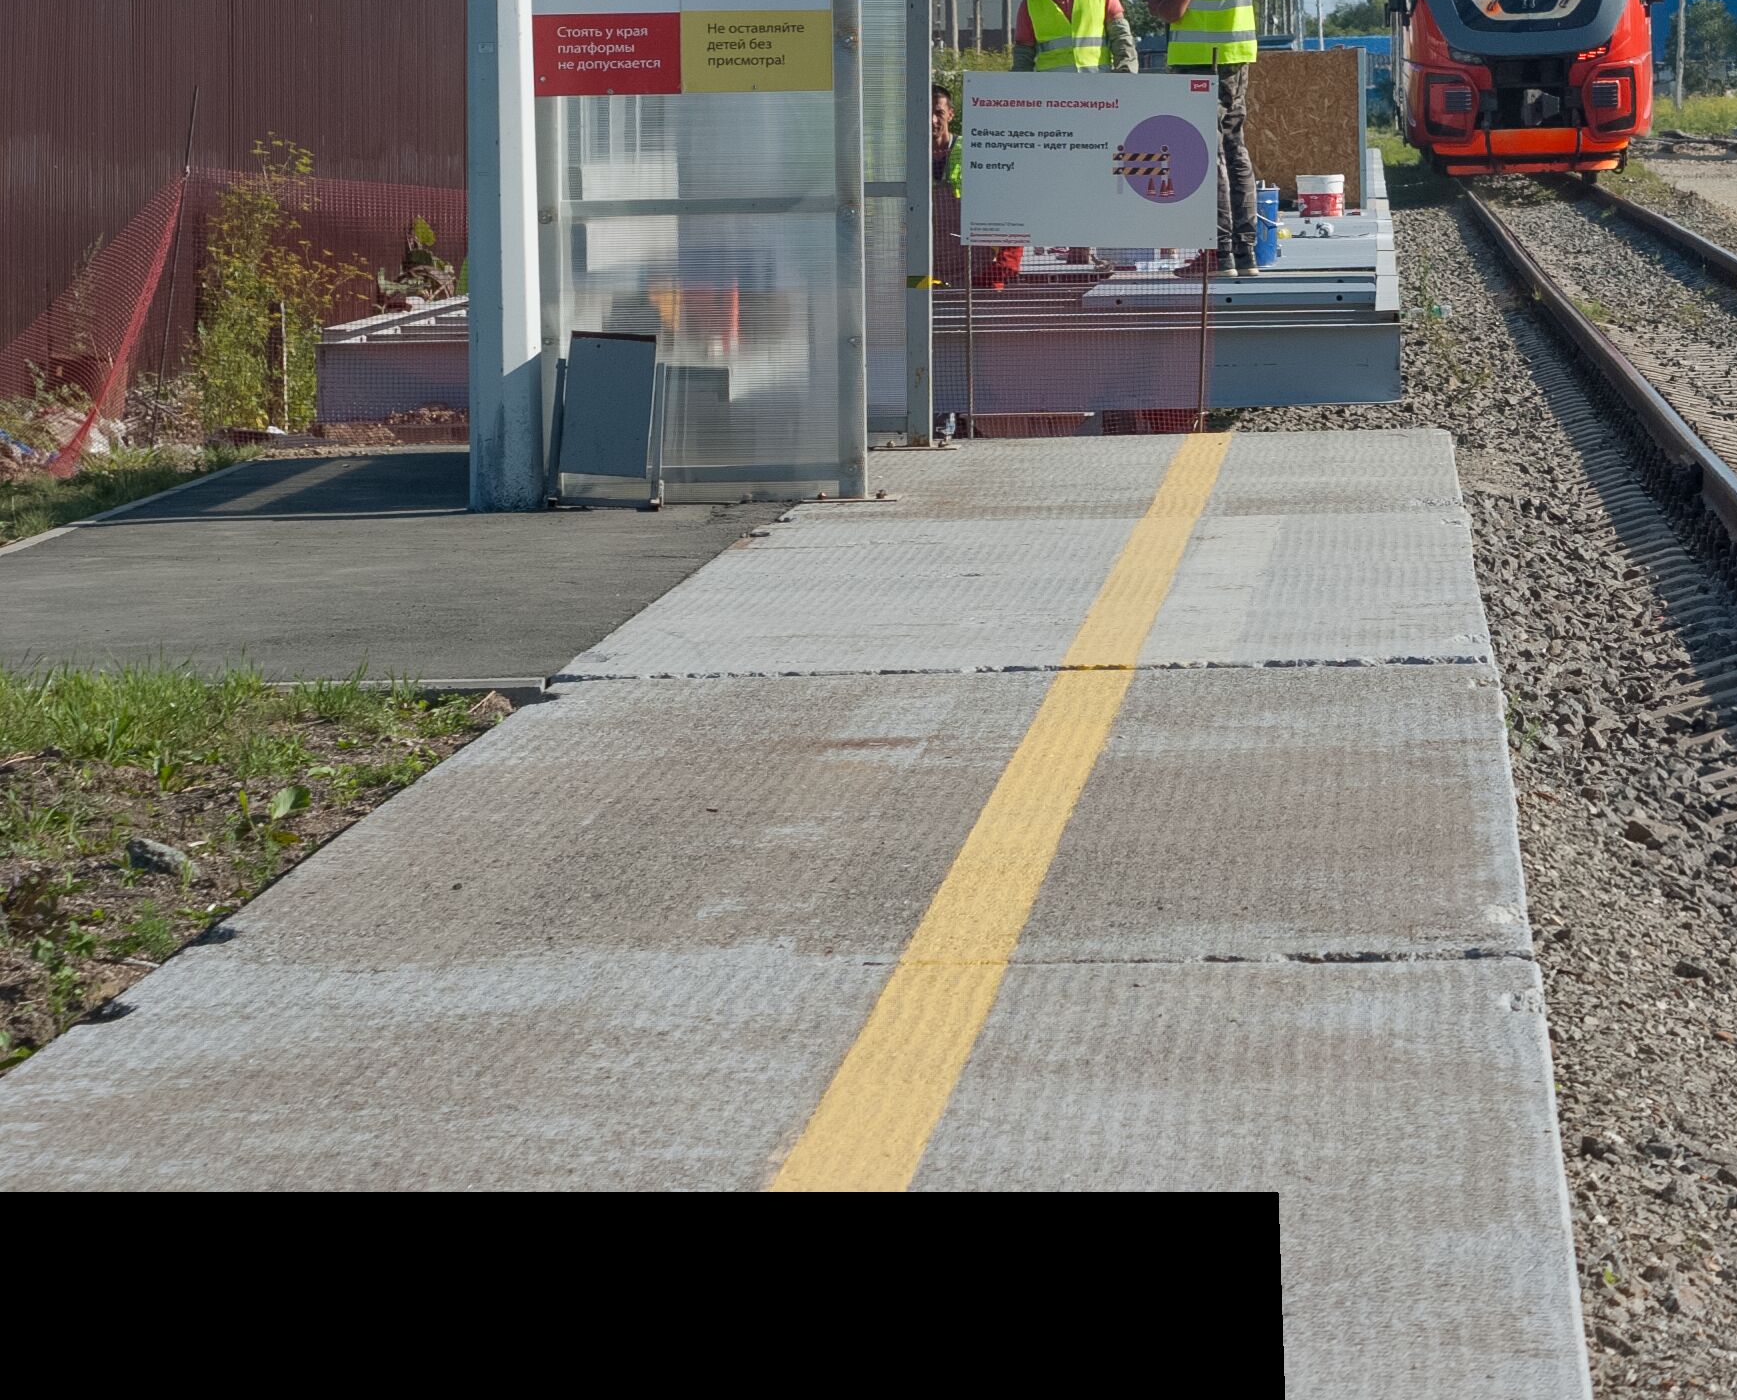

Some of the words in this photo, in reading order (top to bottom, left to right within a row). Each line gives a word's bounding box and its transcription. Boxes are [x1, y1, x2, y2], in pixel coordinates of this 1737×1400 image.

[556, 25, 603, 39] Стоять
[605, 27, 614, 41] у
[616, 27, 649, 40] края
[707, 23, 726, 34] Не
[728, 22, 806, 35] оставляйте
[557, 41, 636, 56] платформы
[706, 38, 746, 51] детей
[749, 37, 773, 50] без
[557, 59, 576, 71] не
[577, 58, 662, 73] допускается
[707, 54, 786, 68] присмотра!
[971, 96, 1043, 108] Уважаемые
[1046, 98, 1120, 111] пассажиры!
[970, 127, 1006, 138] Сейчас
[1007, 129, 1036, 139] здесь
[1037, 128, 1074, 140] пройти
[970, 141, 983, 149] не
[984, 141, 1036, 151] получится
[1043, 141, 1067, 151] идет
[1069, 141, 1109, 151] ремонт!
[970, 161, 983, 170] No
[985, 161, 1015, 172] entry!
